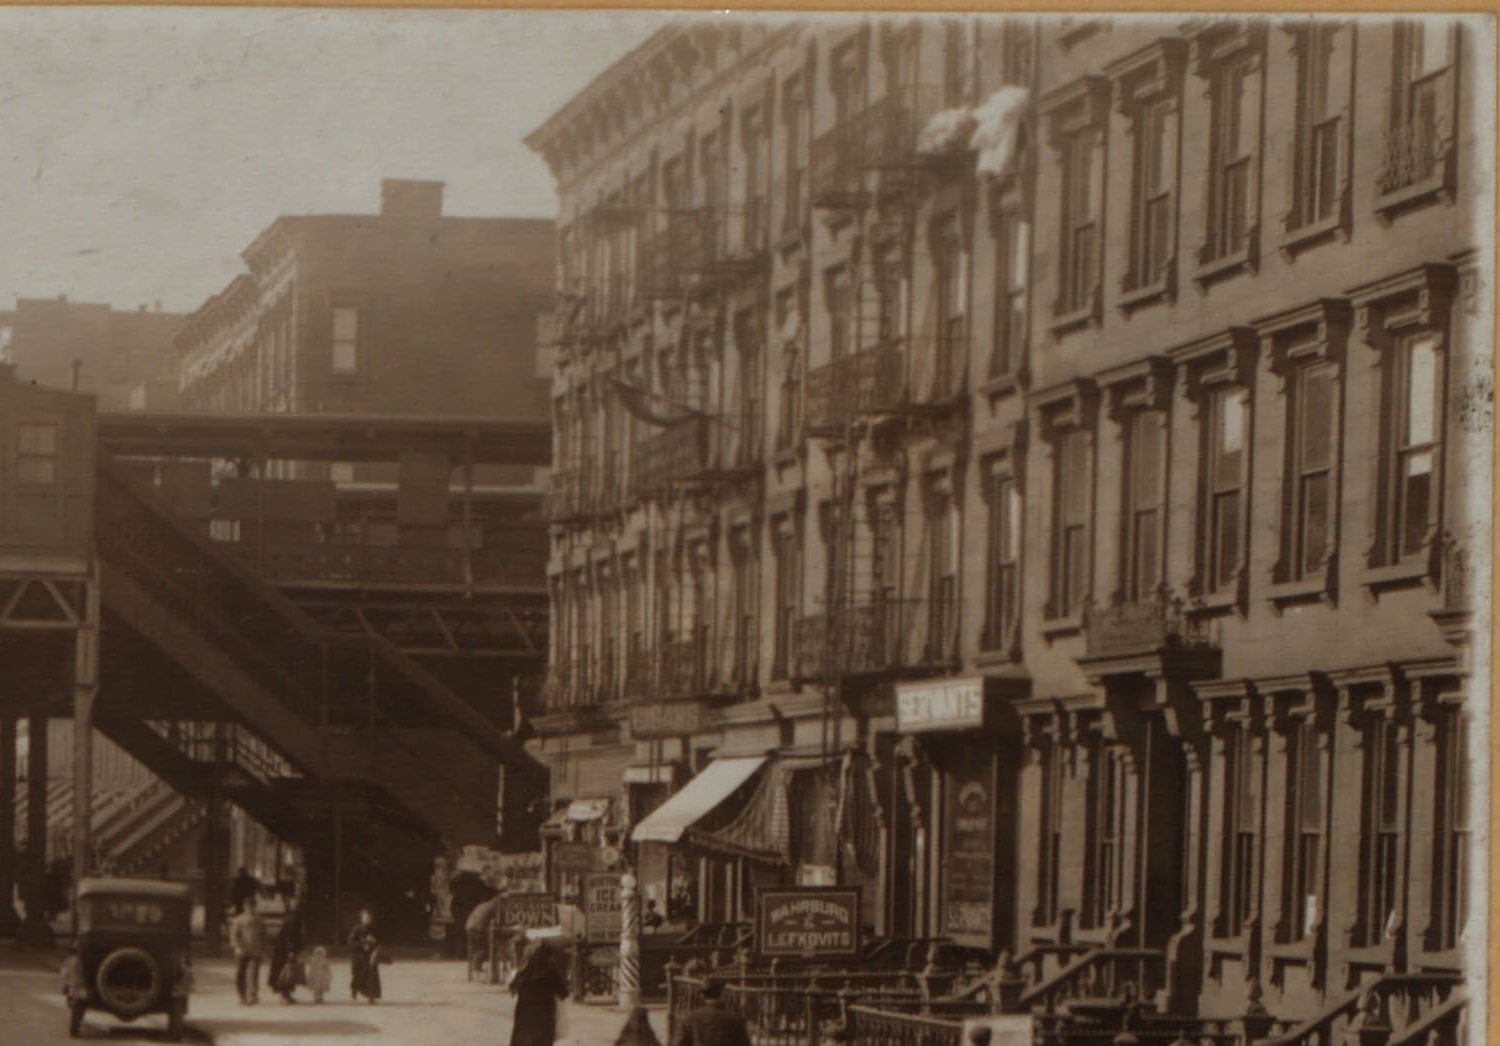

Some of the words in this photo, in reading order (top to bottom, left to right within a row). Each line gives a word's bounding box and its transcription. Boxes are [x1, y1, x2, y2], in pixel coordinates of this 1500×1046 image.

[596, 889, 616, 901] ICE
[505, 911, 556, 928] DOWN
[804, 913, 815, 929] &
